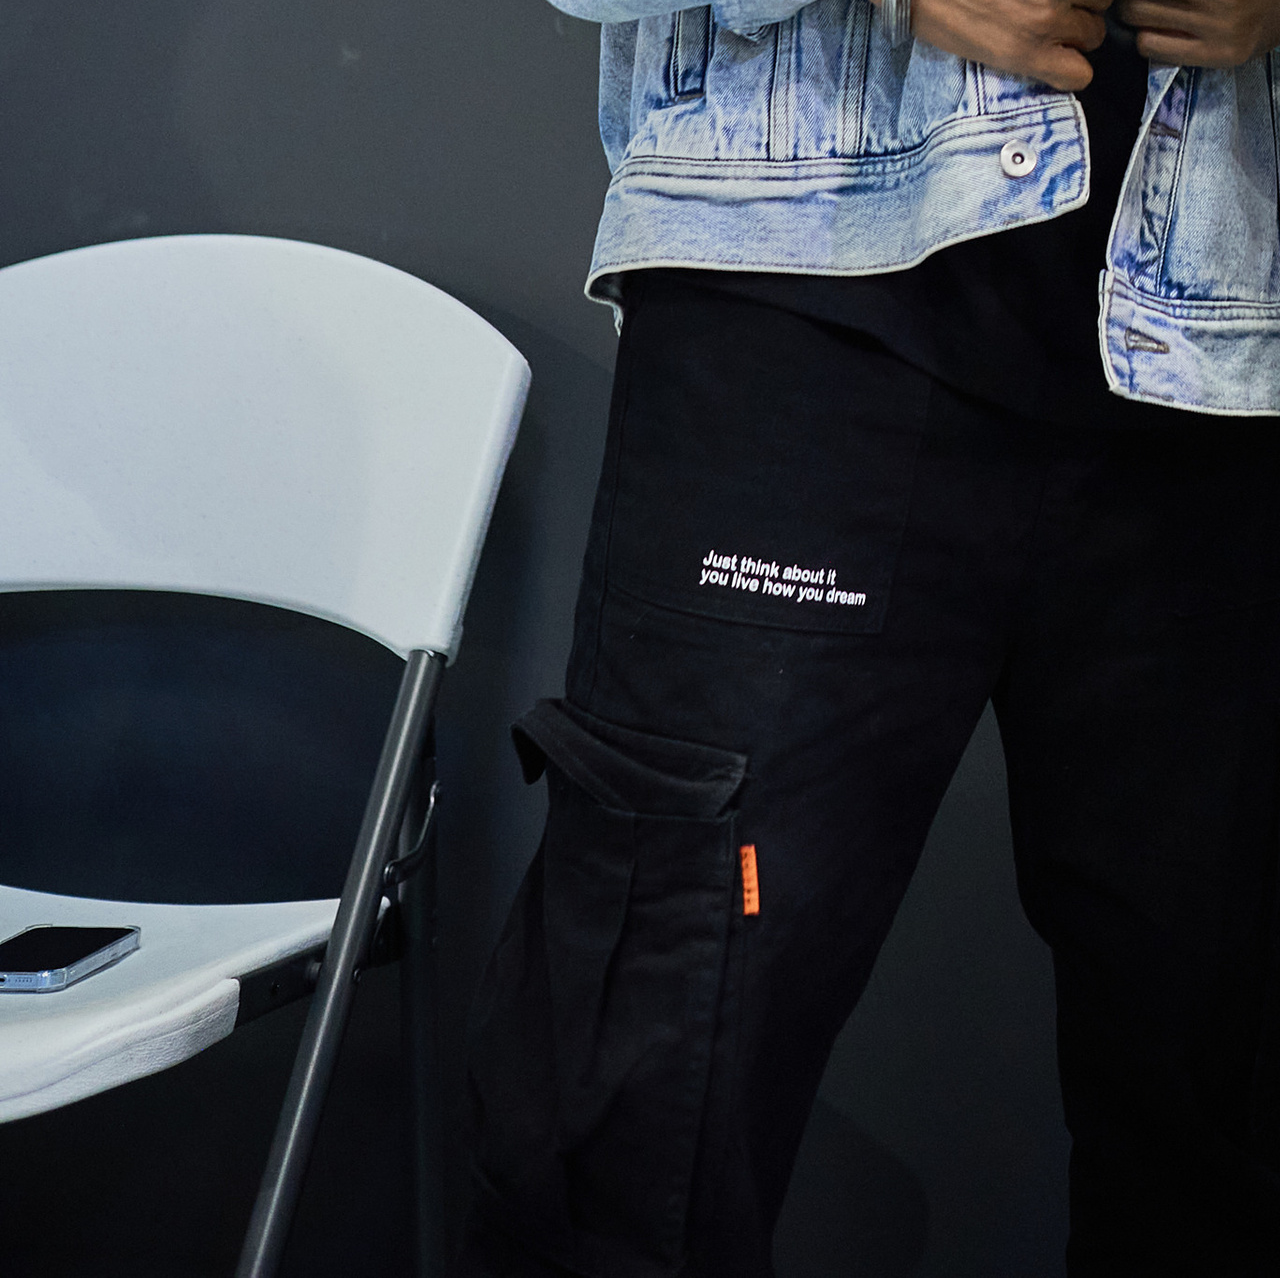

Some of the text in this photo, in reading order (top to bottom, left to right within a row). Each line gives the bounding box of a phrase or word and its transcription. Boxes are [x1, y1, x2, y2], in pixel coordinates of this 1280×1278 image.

[703, 550, 837, 586] Just think about it
[699, 568, 867, 606] you live how you dream
